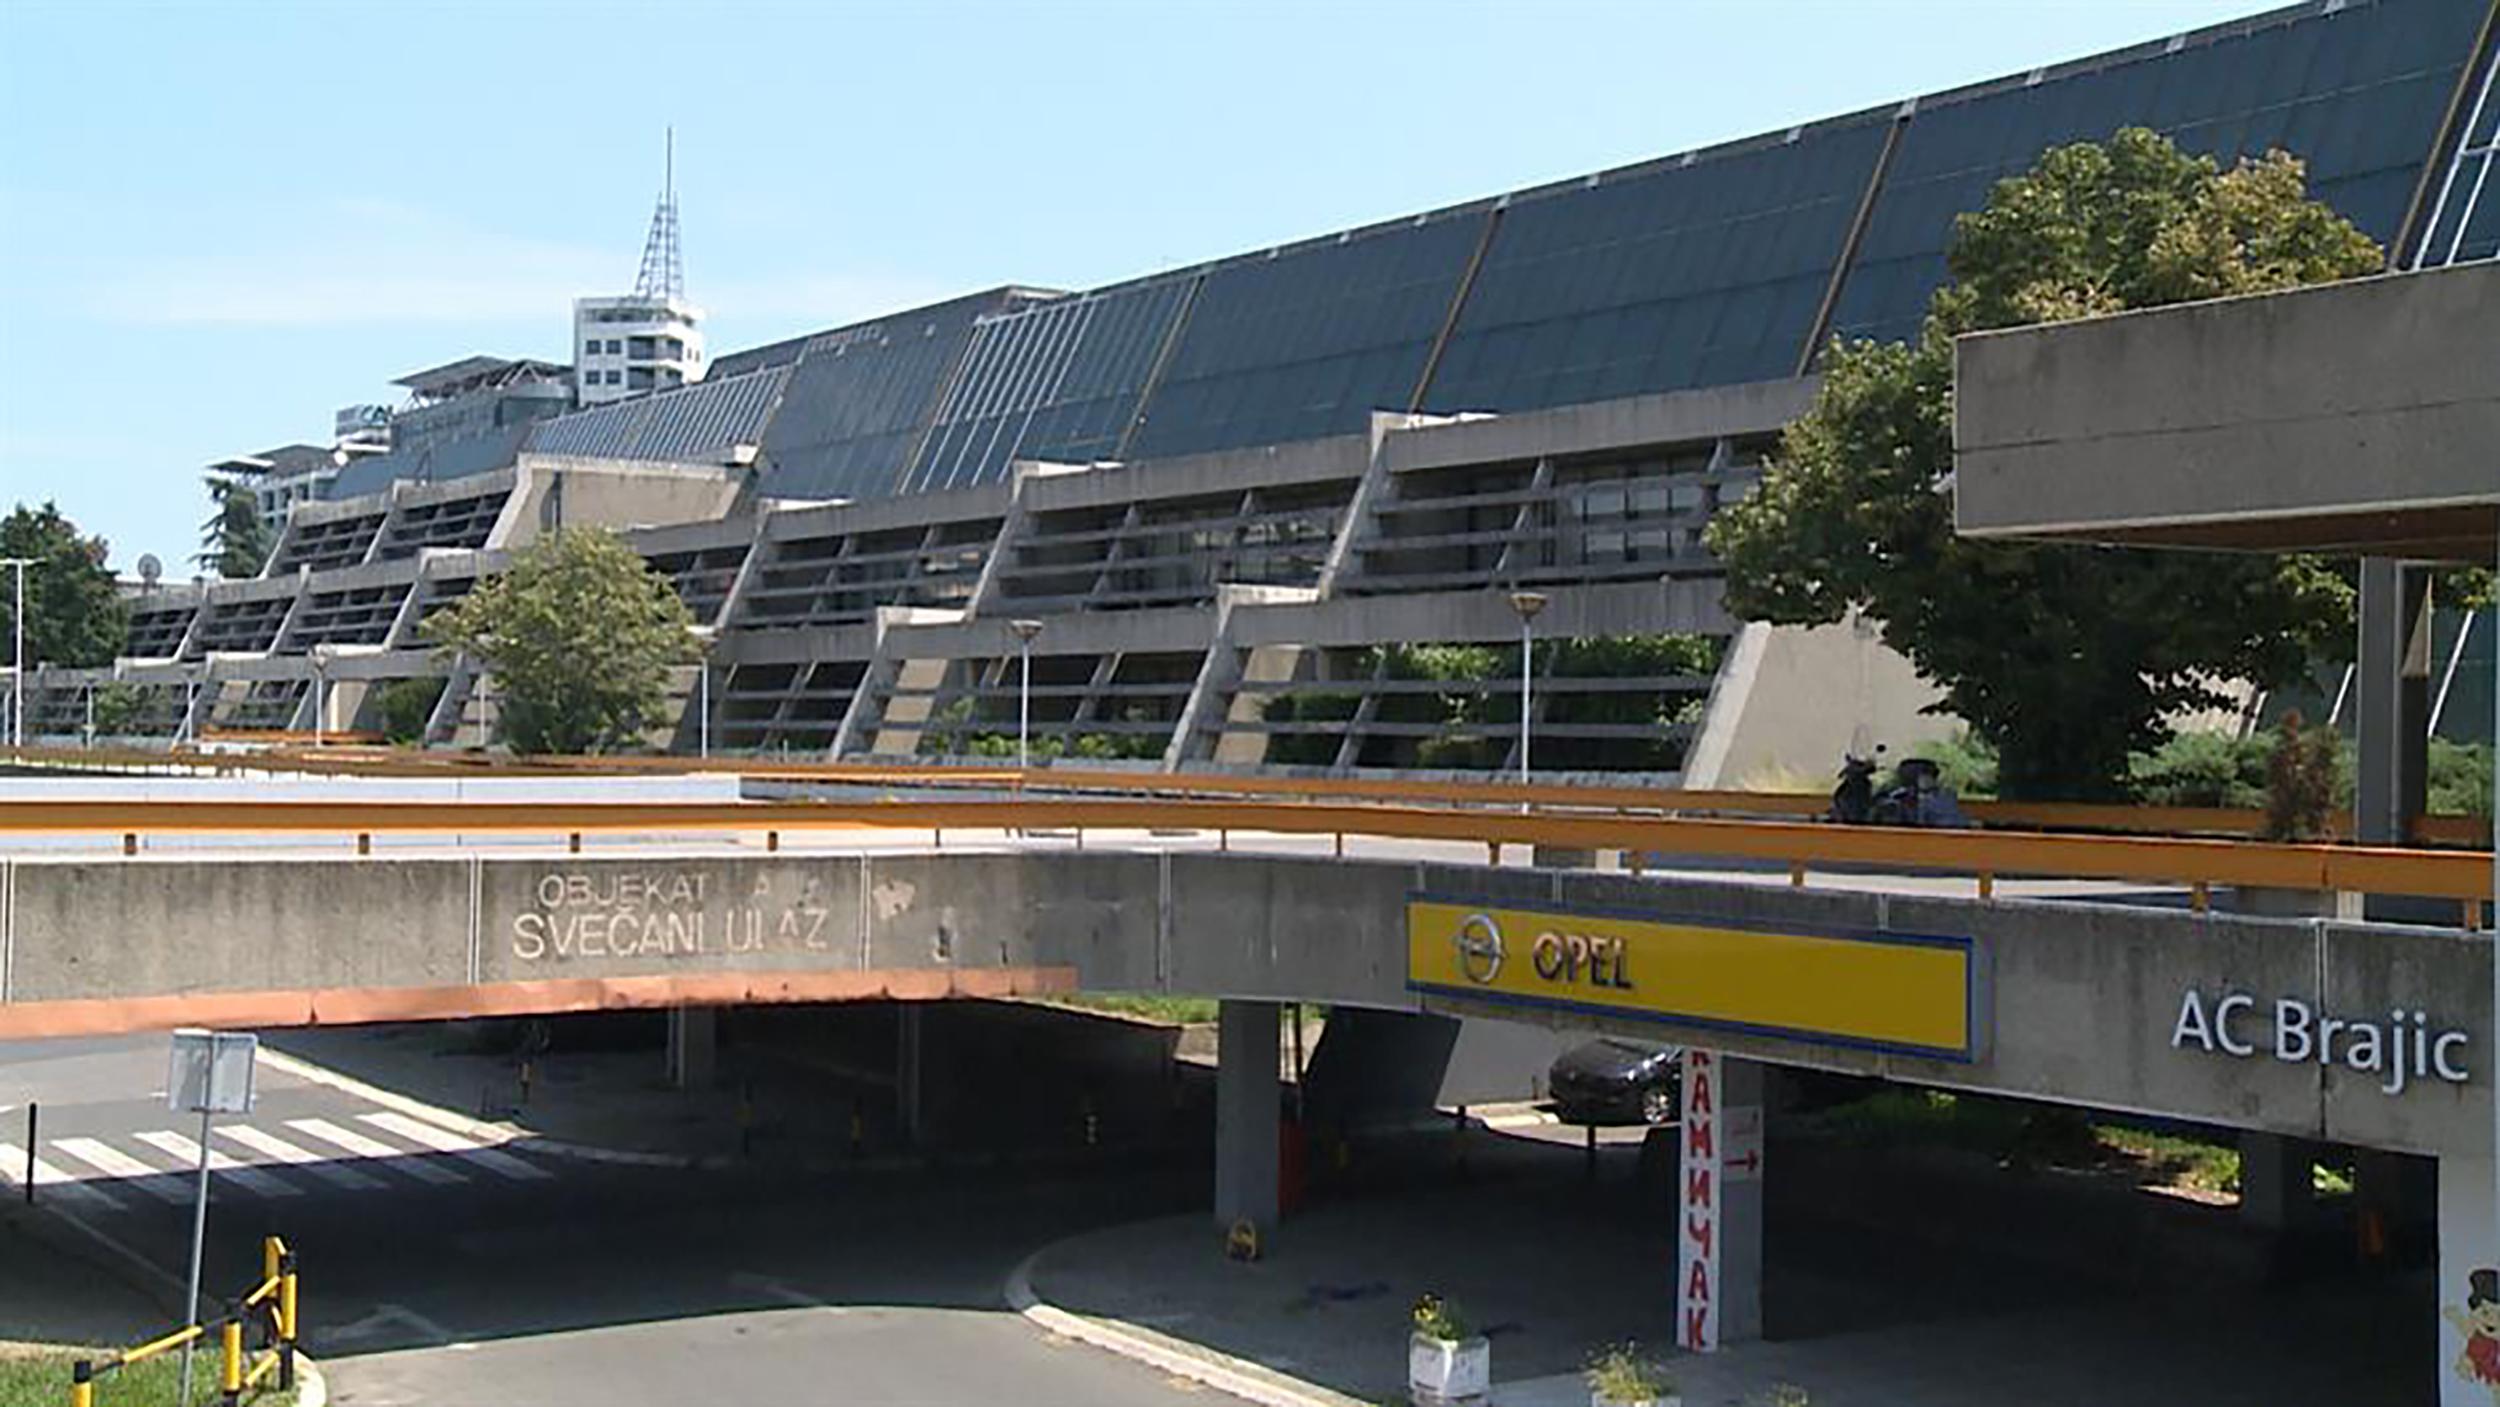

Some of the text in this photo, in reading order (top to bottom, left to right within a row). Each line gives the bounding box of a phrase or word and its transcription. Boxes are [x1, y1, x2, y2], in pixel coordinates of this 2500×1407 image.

[538, 873, 709, 907] OBJEKAT
[513, 904, 705, 959] SVEČANI
[1532, 932, 1632, 989] OPEL
[2171, 989, 2470, 1095] AC Brajic
